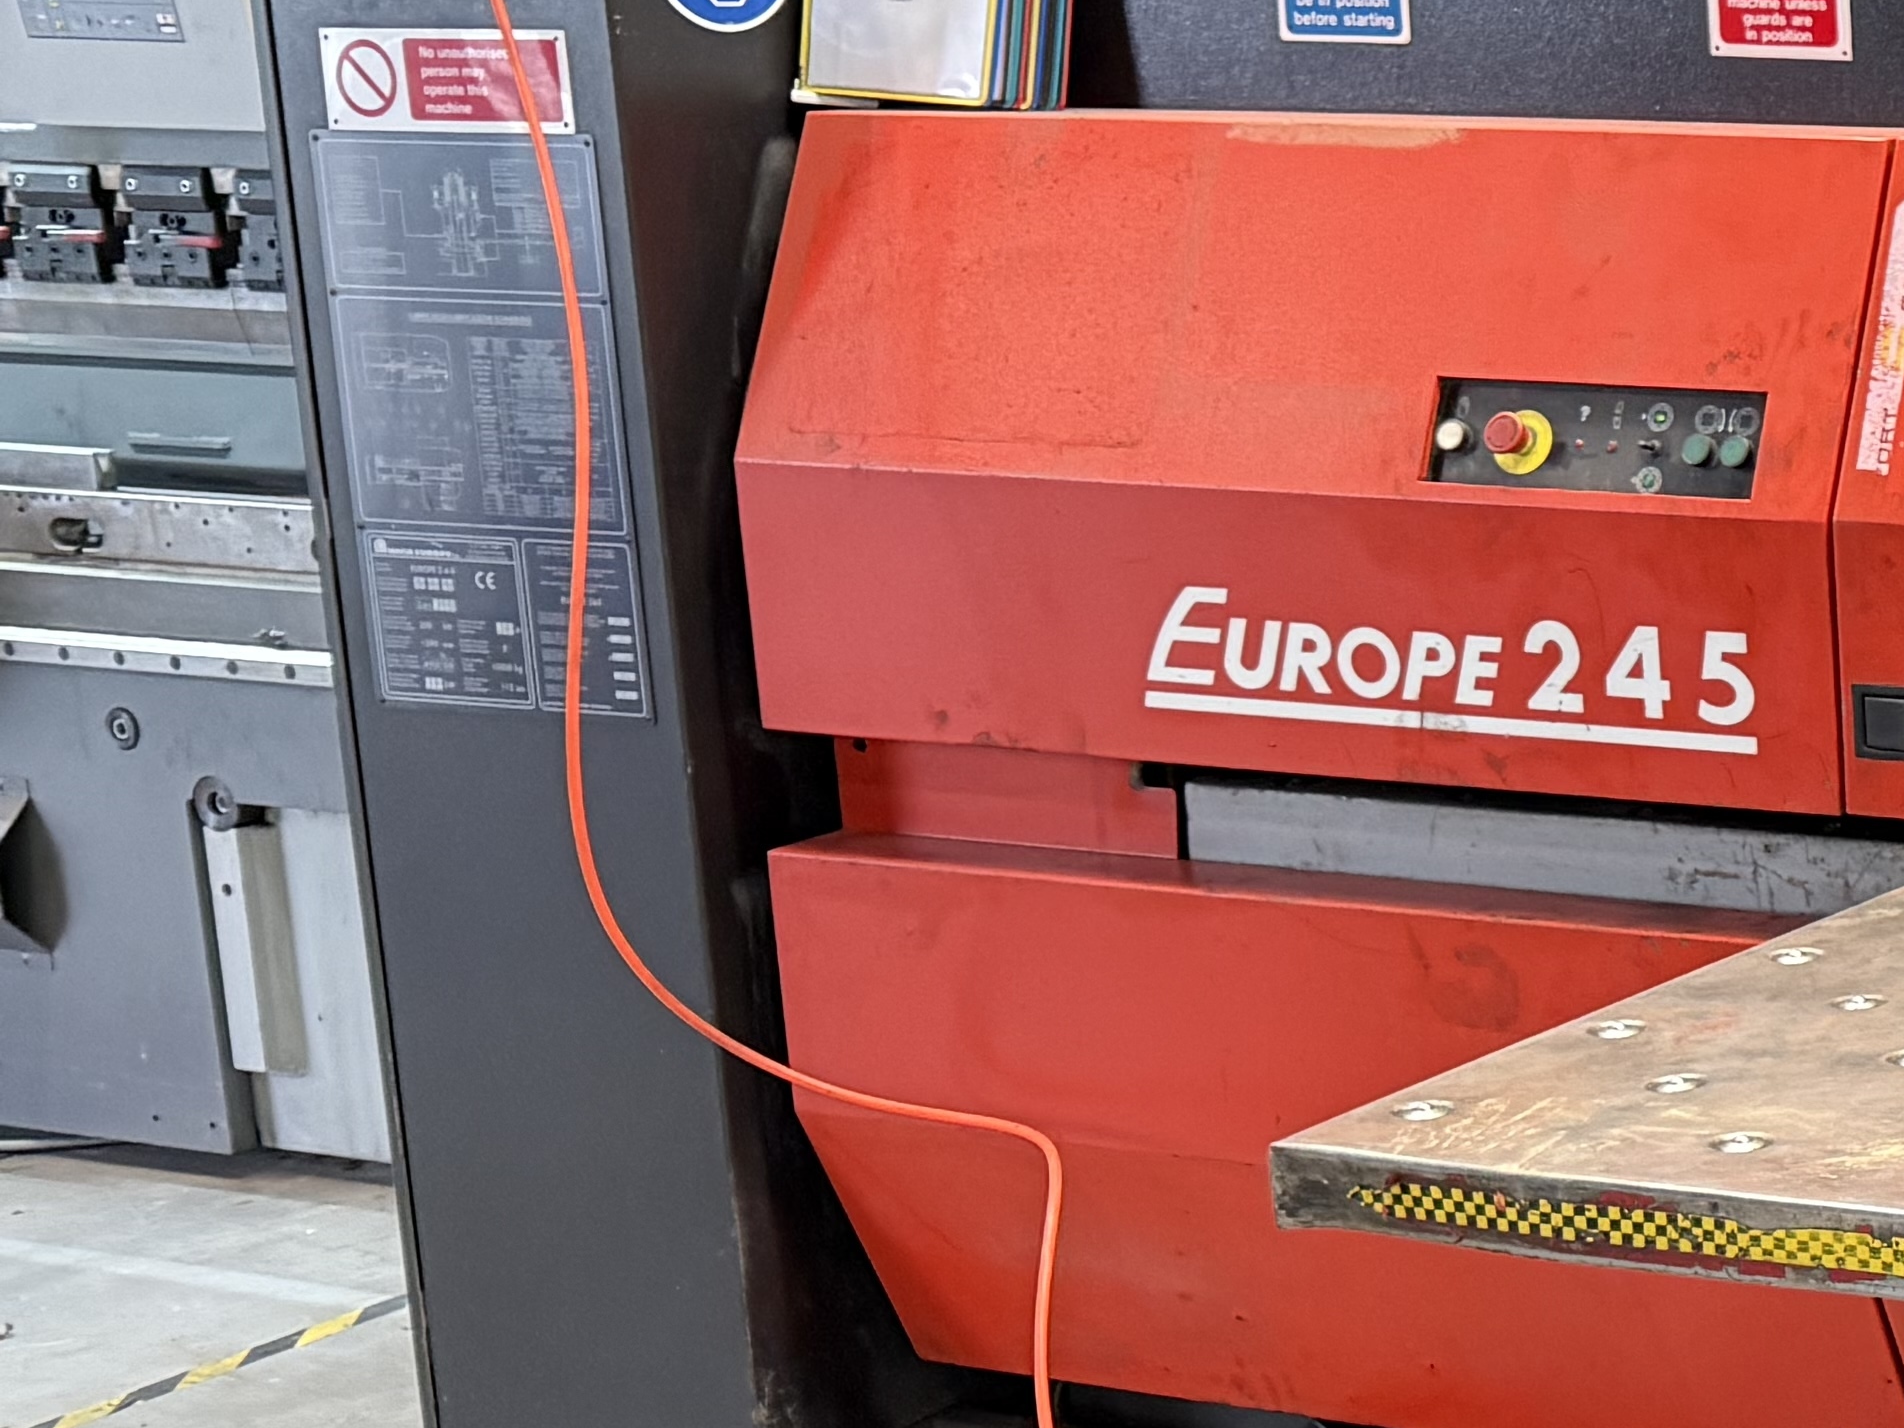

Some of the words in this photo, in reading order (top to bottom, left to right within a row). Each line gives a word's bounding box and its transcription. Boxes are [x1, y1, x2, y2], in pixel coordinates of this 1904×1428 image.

[1293, 10, 1337, 26] before
[1343, 12, 1395, 30] starting
[1742, 12, 1787, 27] guards
[1791, 15, 1813, 27] are
[1745, 27, 1758, 40] in
[1761, 29, 1813, 43] position
[418, 45, 435, 58] No
[420, 67, 459, 79] person
[461, 67, 485, 81] may
[423, 84, 465, 98] operate
[467, 84, 488, 96] this
[425, 102, 472, 114] machine
[1147, 586, 1503, 707] EUROPE
